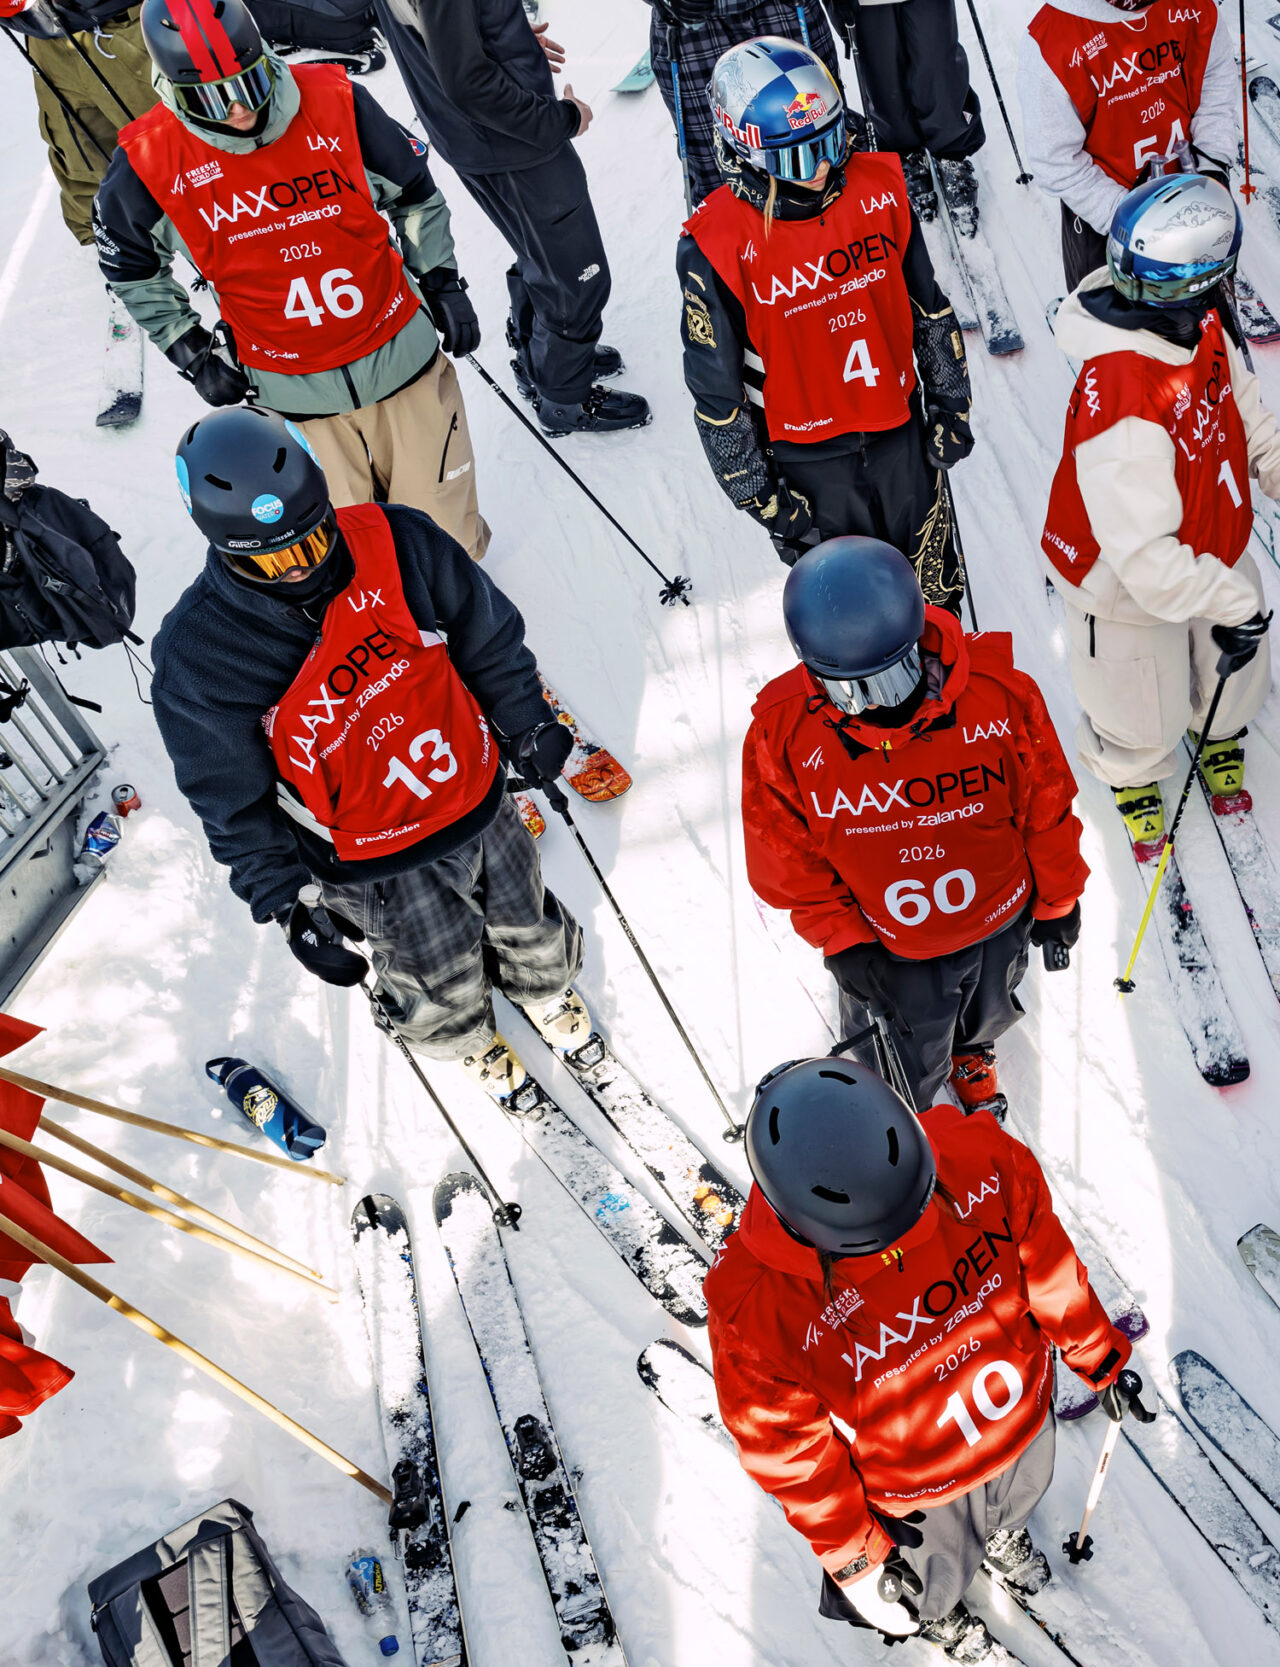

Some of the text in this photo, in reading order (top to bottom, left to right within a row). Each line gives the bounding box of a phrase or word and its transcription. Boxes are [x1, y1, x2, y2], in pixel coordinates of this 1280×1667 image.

[1168, 9, 1202, 24] LAAX
[722, 110, 763, 149] Bull
[788, 101, 828, 131] Red Bull
[1140, 98, 1166, 124] 2026
[1133, 118, 1186, 170] 54
[185, 160, 220, 179] FREESKI
[189, 171, 212, 185] WORLD
[228, 224, 274, 244] presented
[274, 221, 286, 232] by
[280, 242, 322, 263] 2026
[283, 267, 365, 327] 46
[784, 299, 827, 318] presented
[828, 292, 838, 304] by
[828, 309, 867, 333] 2026
[842, 338, 880, 387] 4
[1083, 367, 1101, 417] LAAX
[1217, 459, 1243, 509] 1
[251, 499, 284, 516] FOCUS
[228, 539, 262, 549] GIRO
[289, 630, 397, 775] LAAXOPE
[319, 658, 410, 760] presented by zalando
[366, 712, 405, 752] 2026
[962, 717, 1012, 745] LAAX
[381, 727, 459, 800] 13
[845, 801, 984, 836] presented by zalando
[899, 844, 946, 864] 2026
[884, 868, 977, 927] 60
[984, 879, 1027, 927] swissski
[955, 1171, 1001, 1219] LAAX
[873, 1338, 930, 1390] presented
[928, 1332, 944, 1350] by
[934, 1336, 982, 1382] 2026
[936, 1359, 1024, 1448] 10
